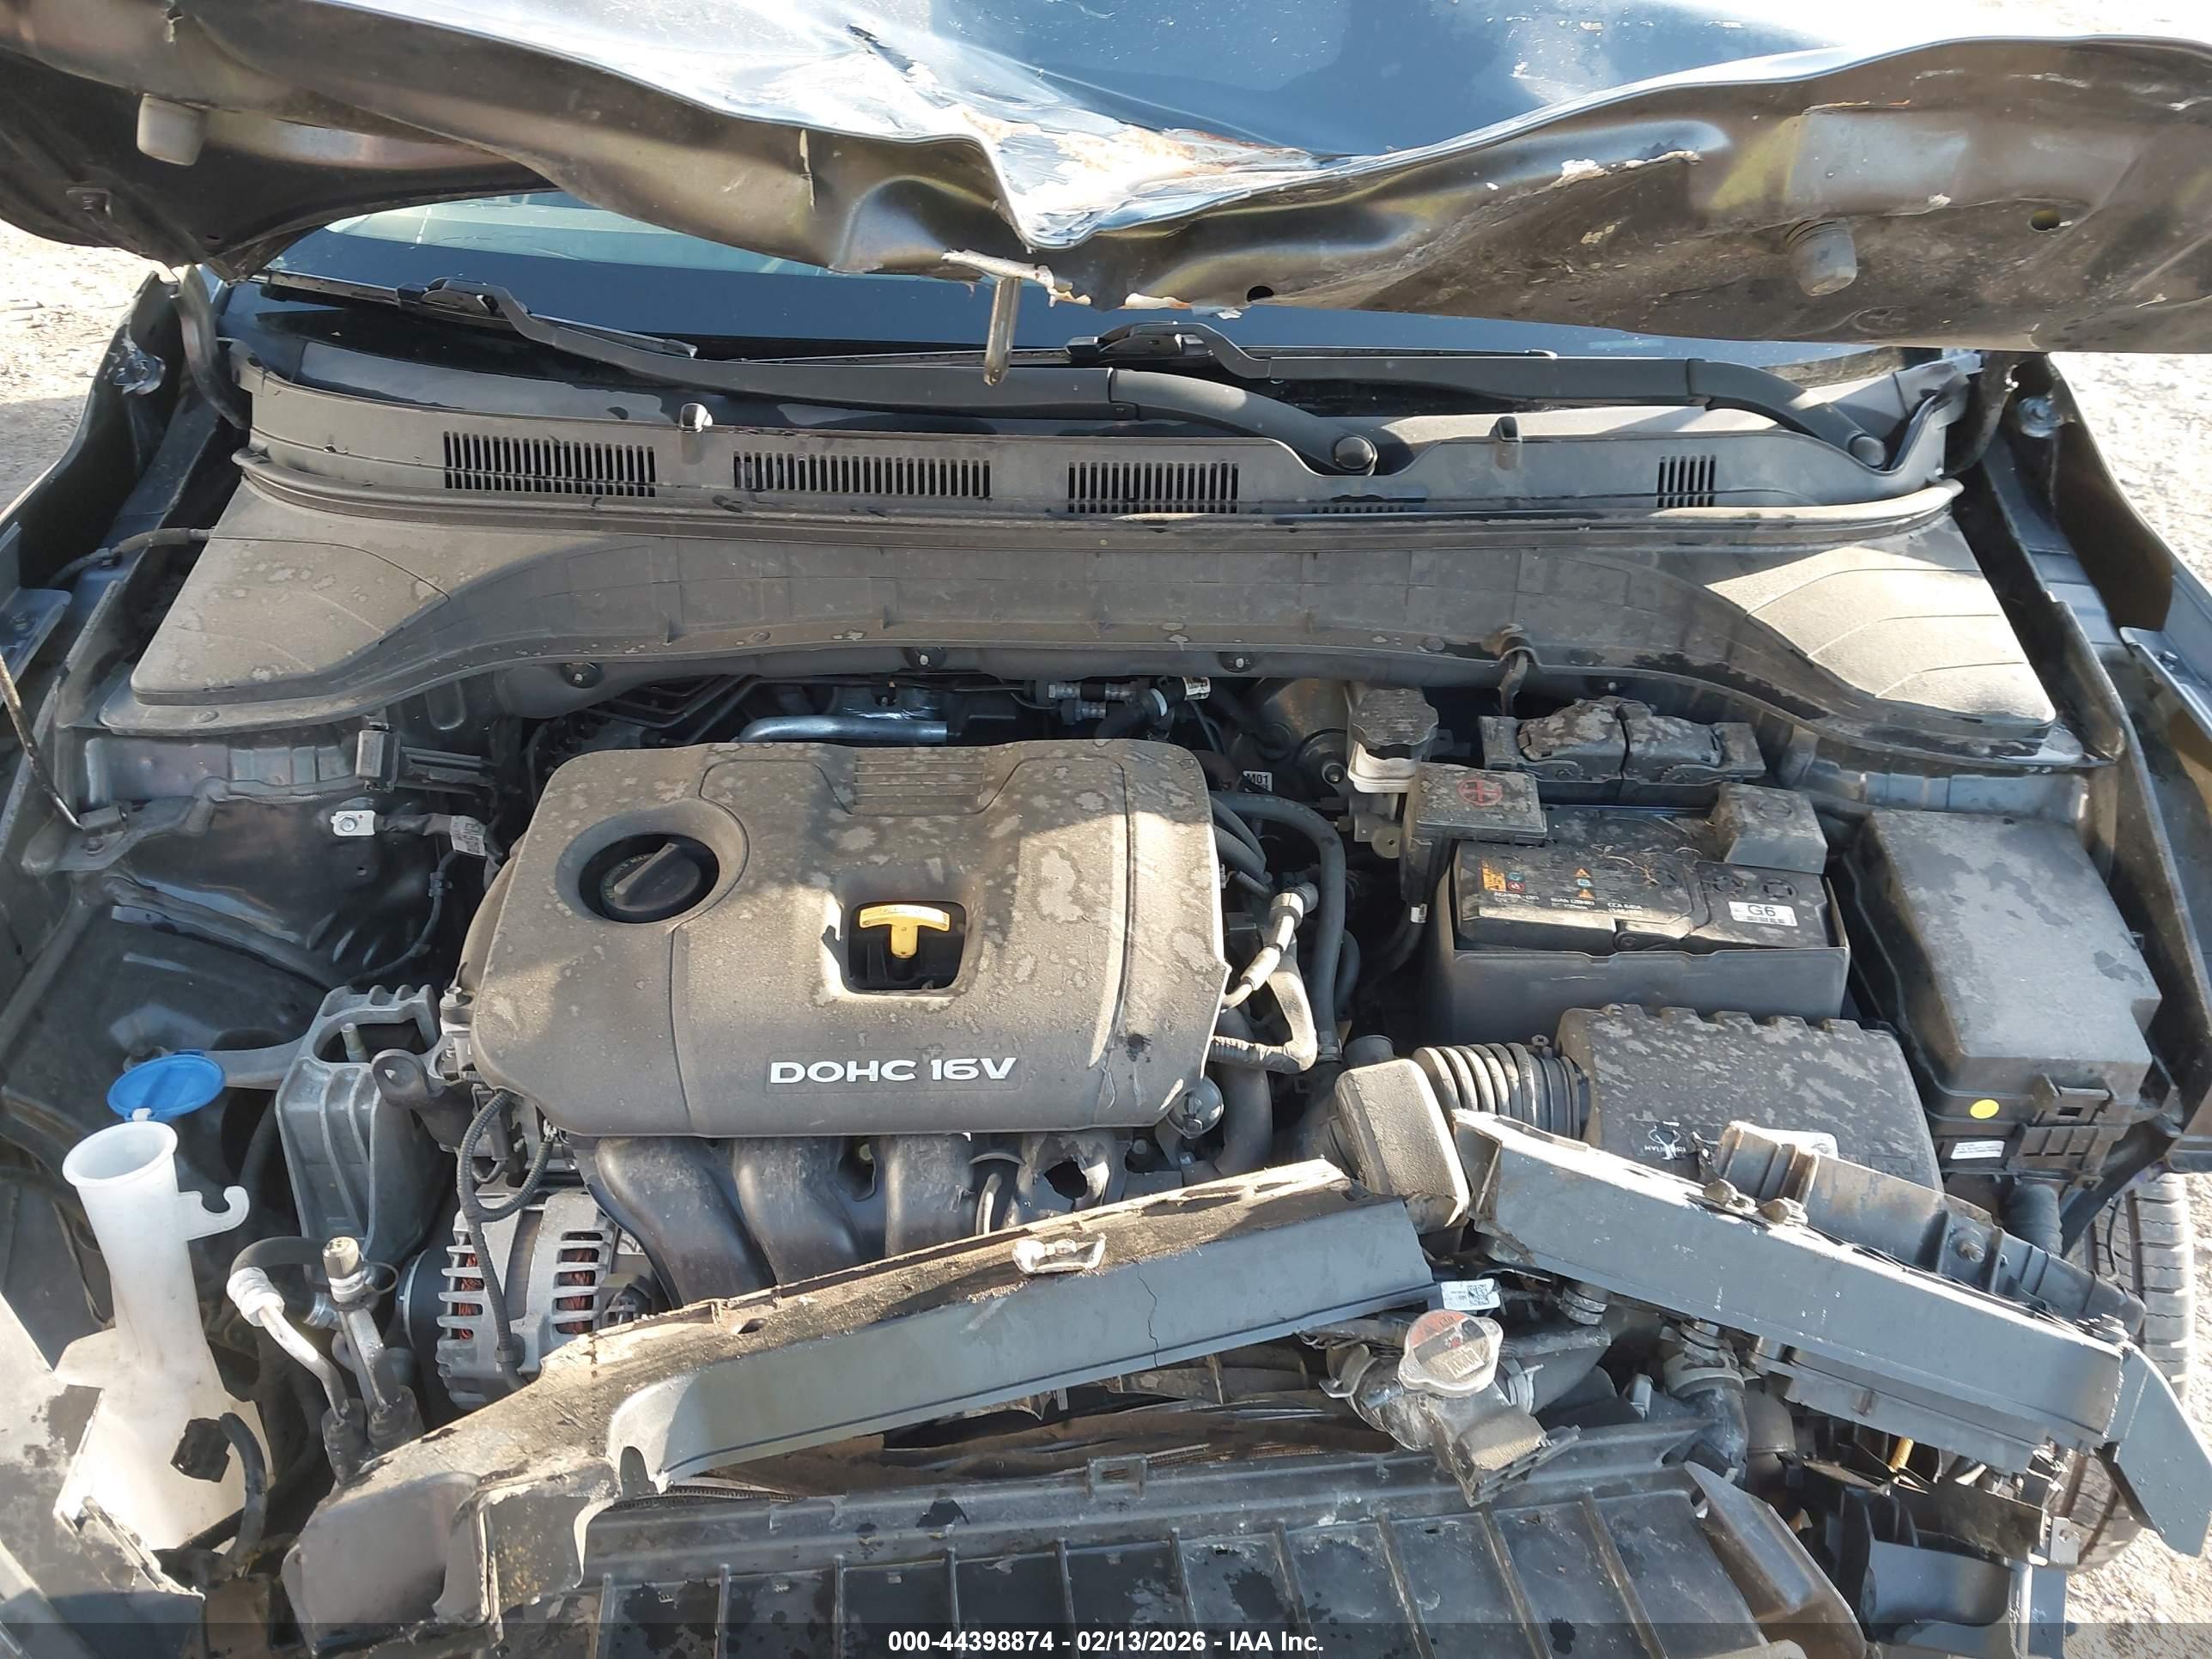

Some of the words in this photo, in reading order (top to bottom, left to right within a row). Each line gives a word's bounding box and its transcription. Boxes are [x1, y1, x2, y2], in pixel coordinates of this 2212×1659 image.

[1747, 904, 1776, 916] G6
[770, 1060, 916, 1084] DOHC
[931, 1057, 1017, 1080] 16V
